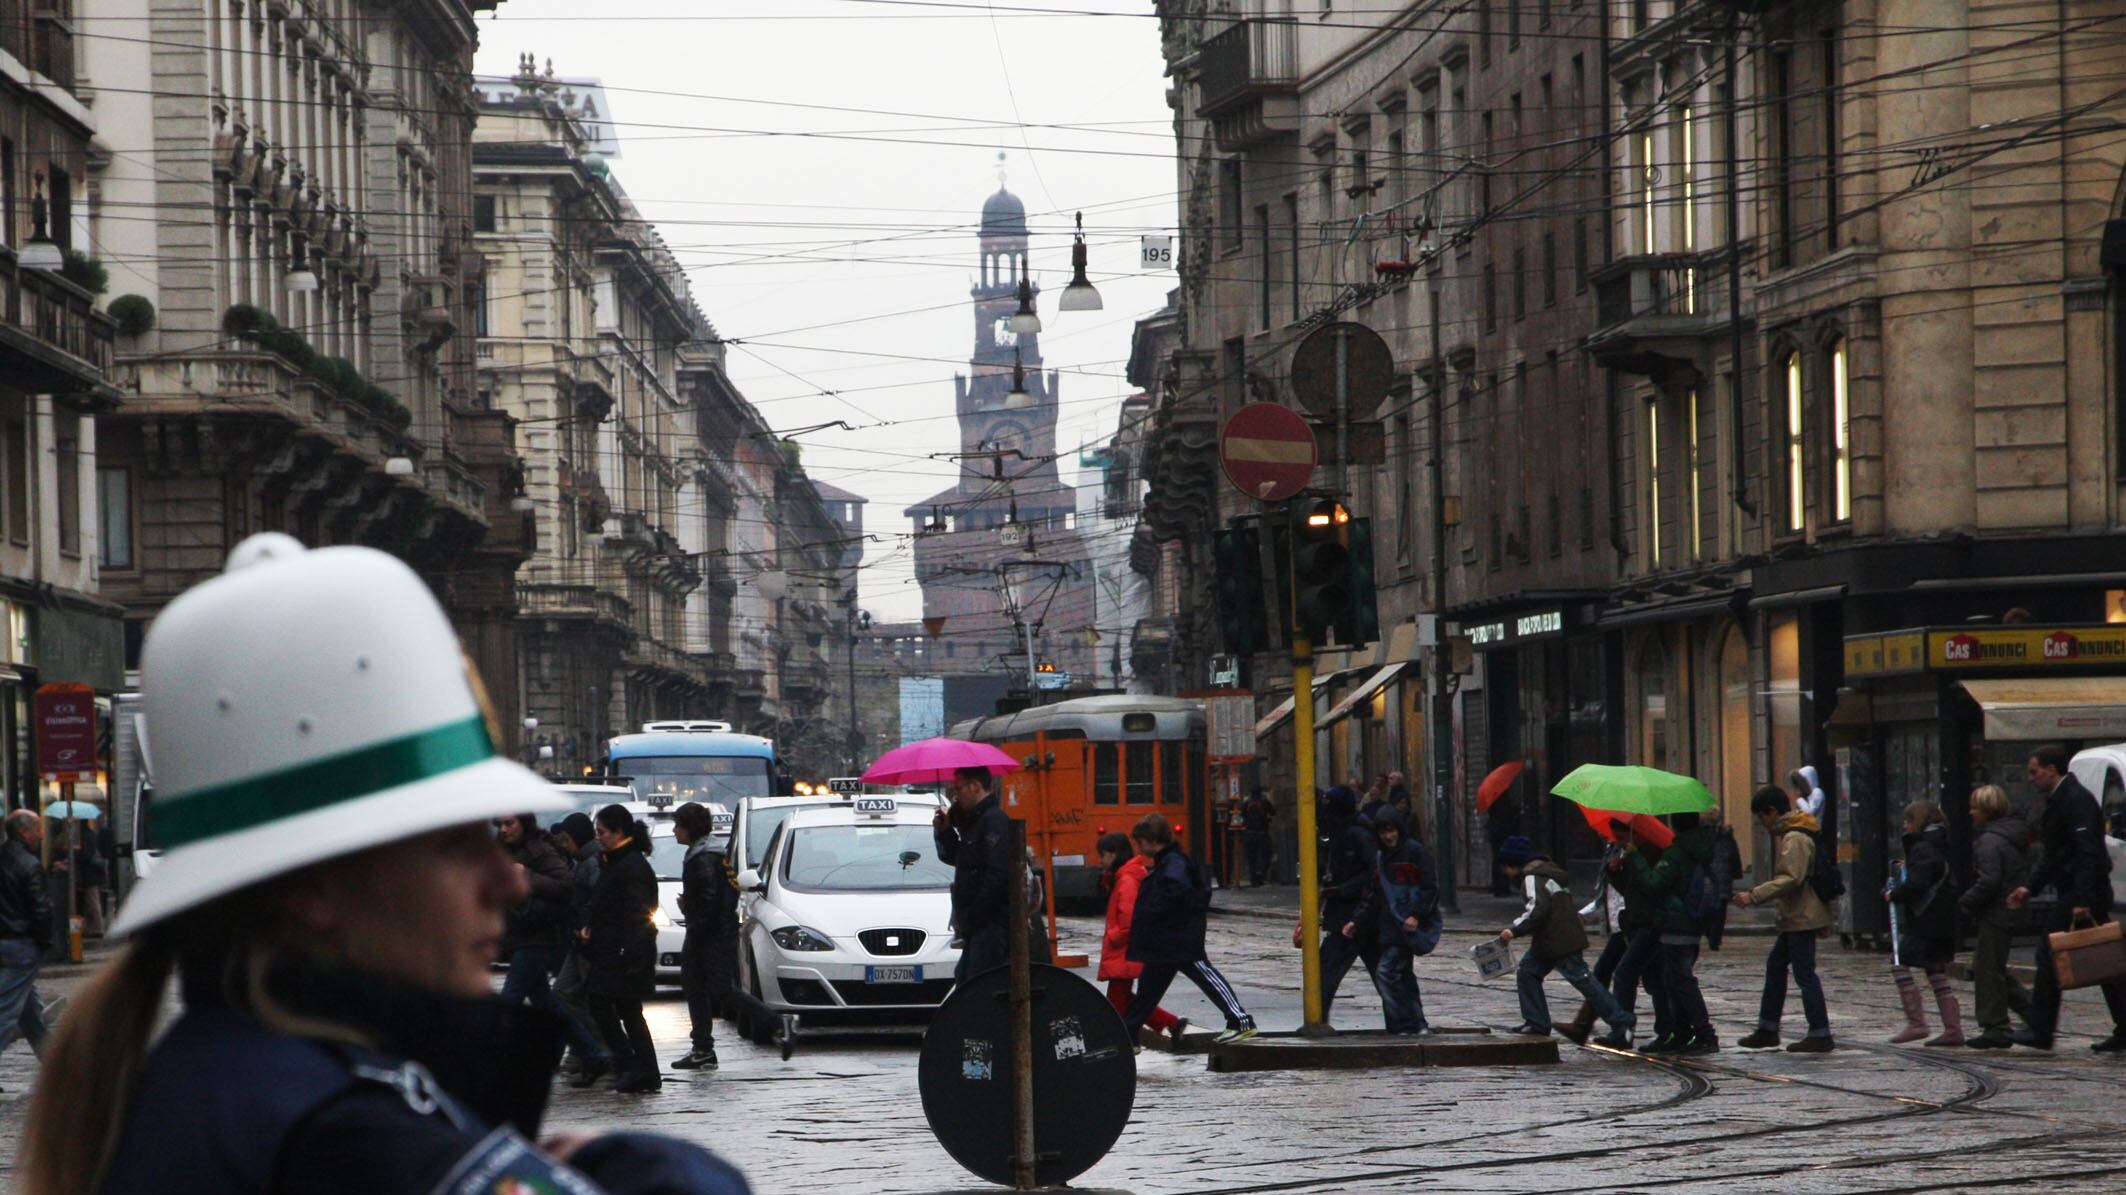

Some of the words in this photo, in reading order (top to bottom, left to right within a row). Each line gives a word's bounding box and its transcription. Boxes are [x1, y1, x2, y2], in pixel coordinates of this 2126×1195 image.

[1142, 247, 1170, 262] 195
[1001, 532, 1017, 541] 192
[832, 781, 861, 791] TAXI
[649, 796, 672, 804] TAXI
[859, 800, 892, 810] TAXI
[712, 815, 731, 823] AXI
